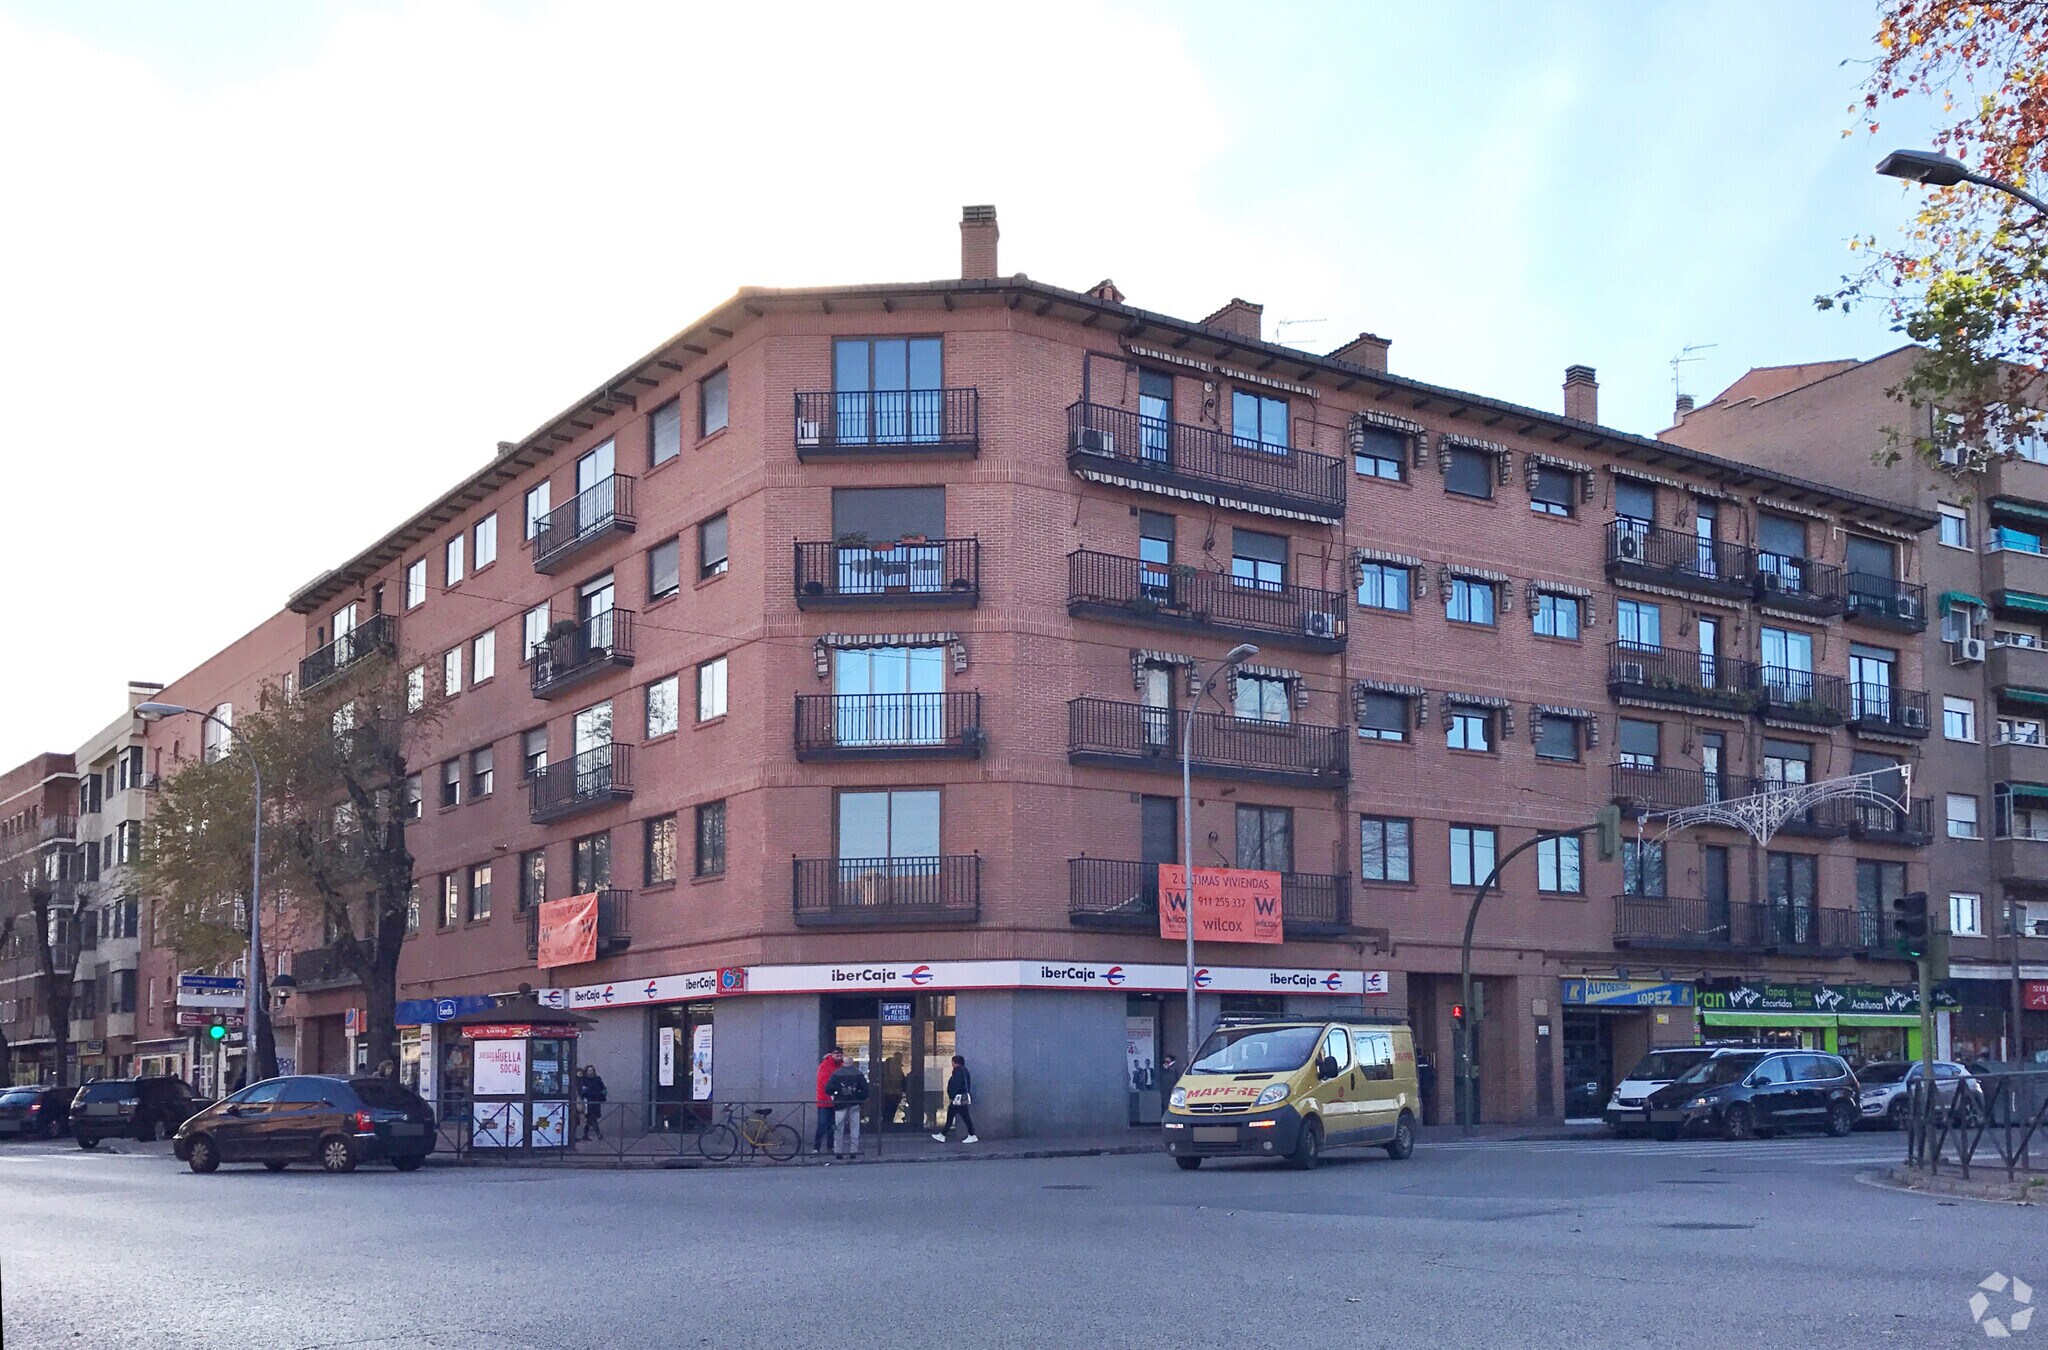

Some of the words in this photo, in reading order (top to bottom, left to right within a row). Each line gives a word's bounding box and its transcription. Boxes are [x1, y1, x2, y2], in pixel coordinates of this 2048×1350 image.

[1171, 873, 1178, 884] 2
[1222, 877, 1269, 890] VIVIENDAS
[1198, 896, 1212, 906] 911
[1215, 897, 1230, 907] 255
[1232, 898, 1246, 908] 337
[1254, 896, 1276, 915] W
[1202, 917, 1242, 932] wilcox
[831, 968, 896, 983] iberCaja
[1040, 966, 1096, 982] iberCaja
[1270, 973, 1317, 988] iberCaja
[685, 974, 716, 991] iberCaja
[575, 989, 600, 1002] iberCaja
[1764, 986, 1788, 999] Tapas
[1762, 998, 1793, 1008] Encurtidos
[1851, 1000, 1884, 1010] Aceitunas
[494, 1049, 521, 1062] HUELLA
[500, 1063, 521, 1075] SOCIAL
[1186, 1086, 1262, 1099] MAPFRE
